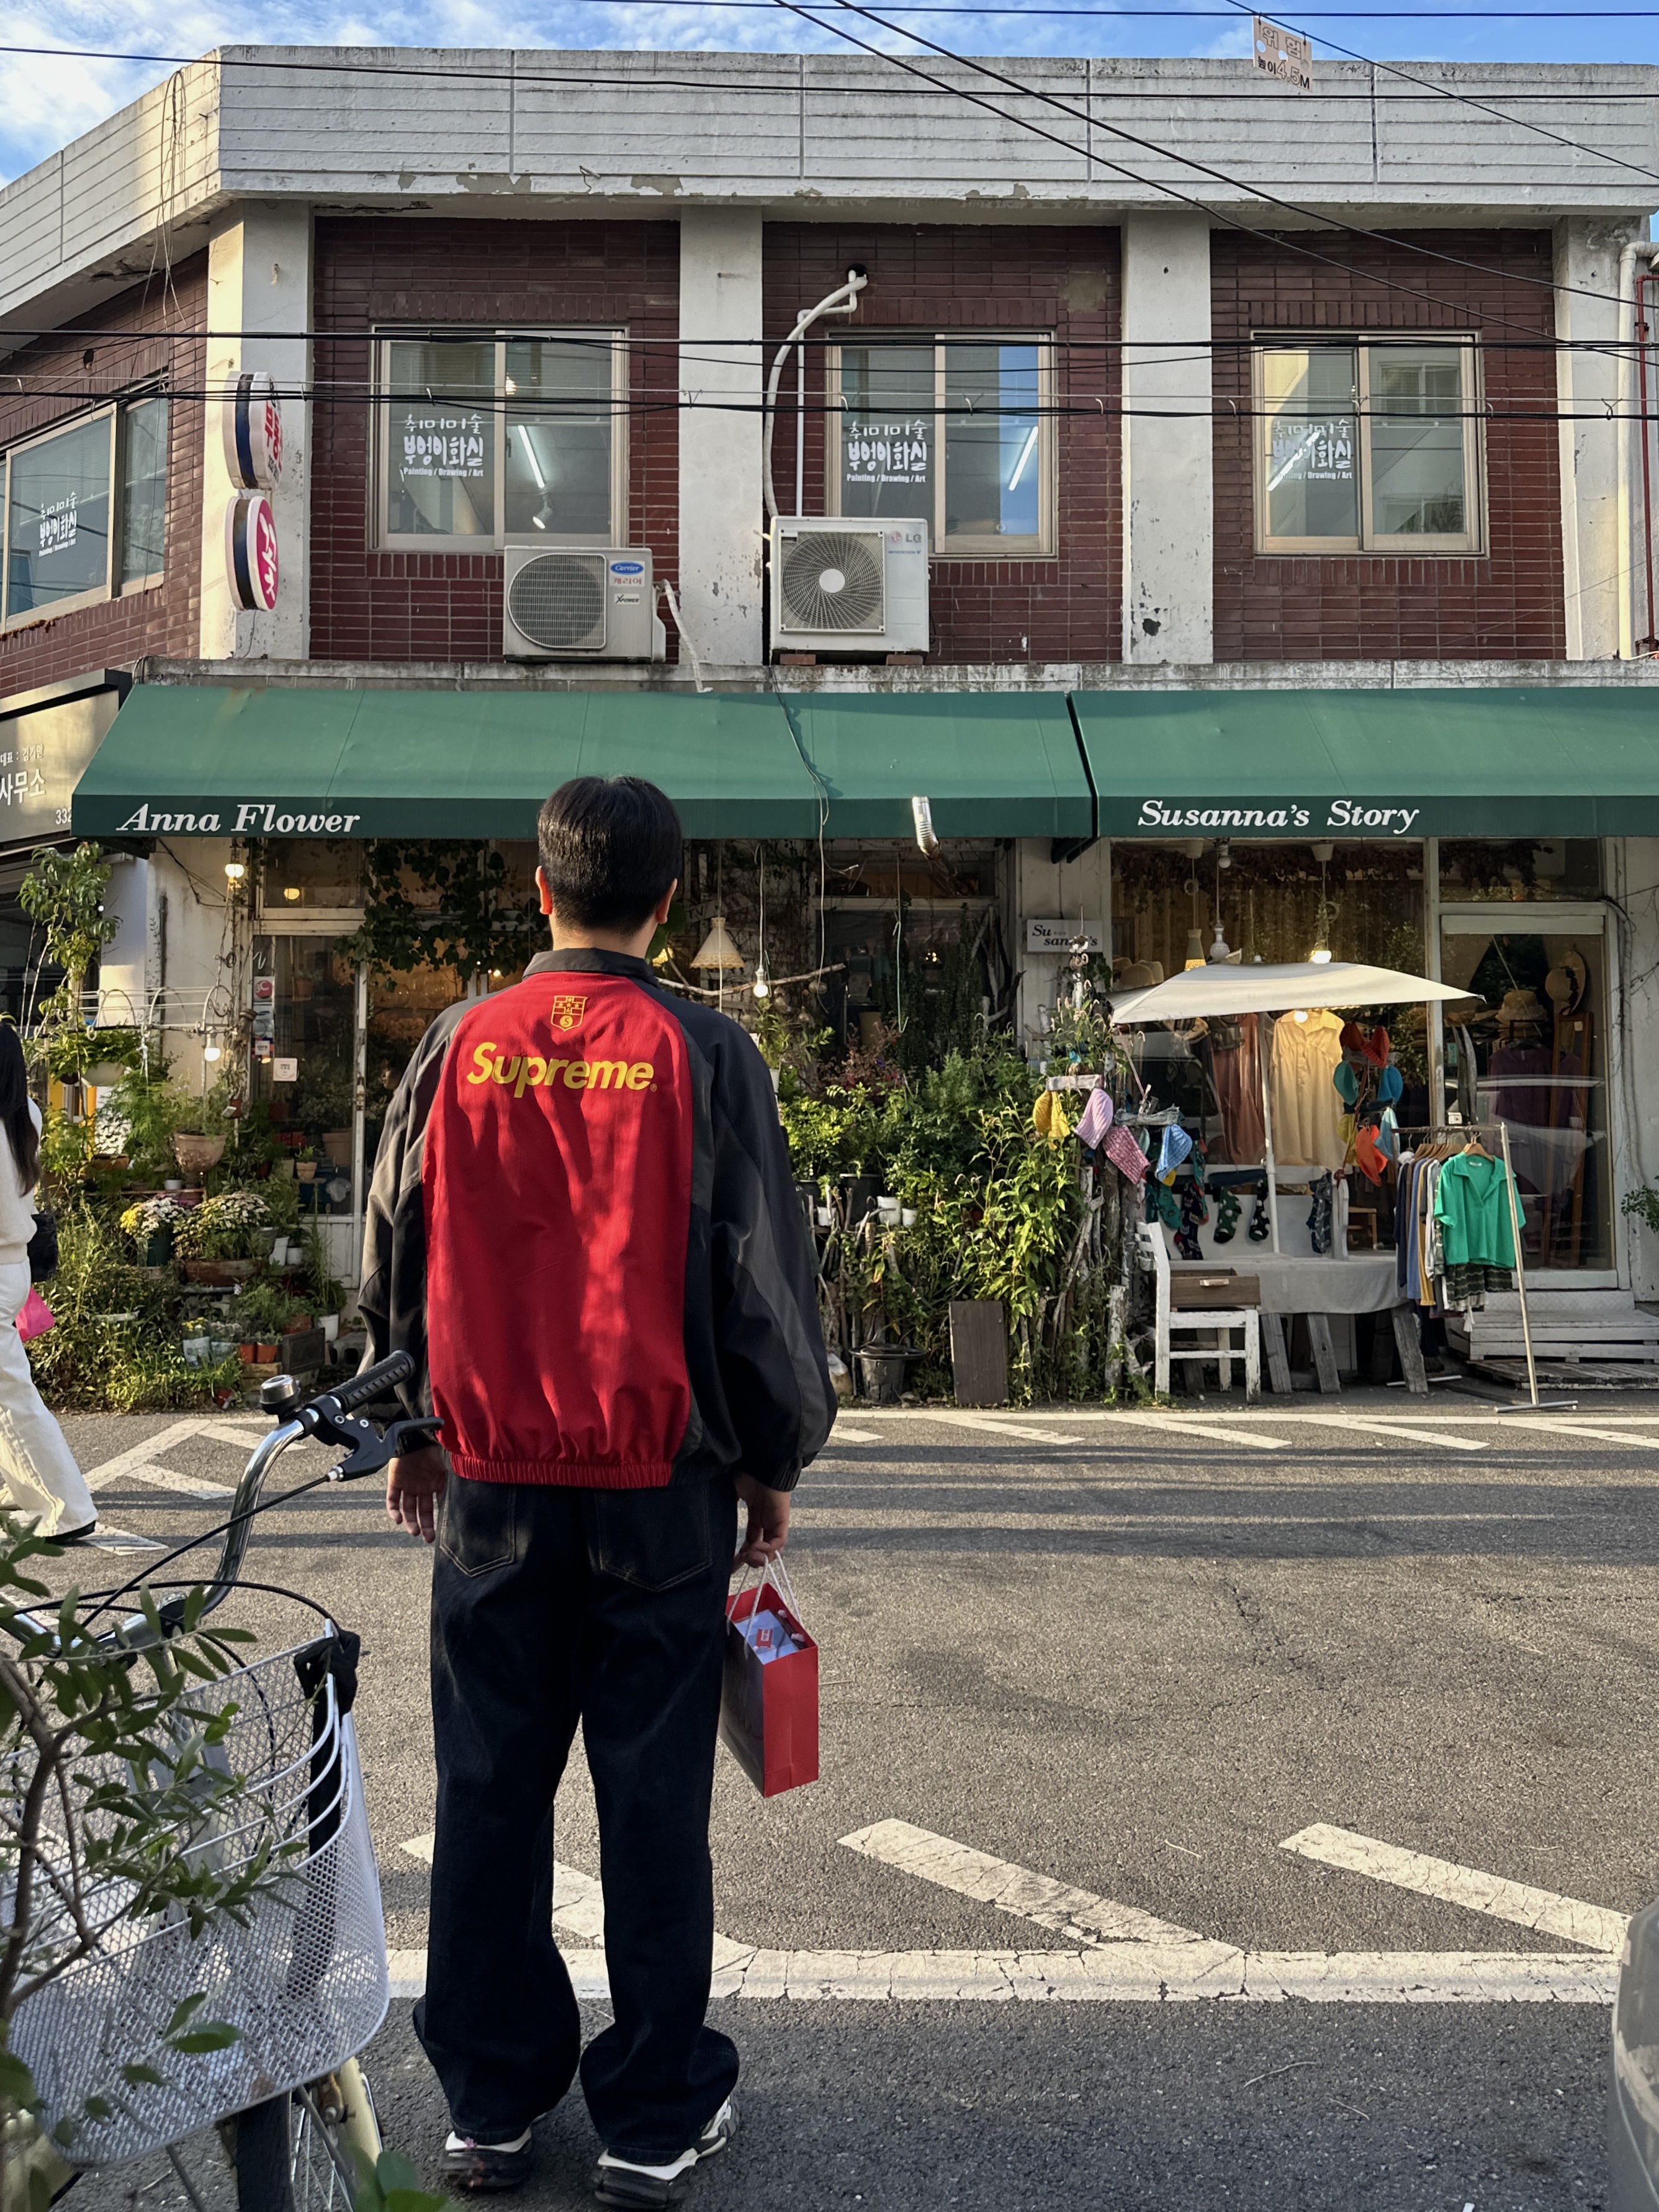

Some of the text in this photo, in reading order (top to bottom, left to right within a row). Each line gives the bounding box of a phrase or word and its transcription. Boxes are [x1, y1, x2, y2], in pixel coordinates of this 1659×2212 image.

[405, 413, 483, 434] 취미미술
[848, 419, 927, 440] 취미미술
[404, 435, 483, 467] 부엉이화실
[848, 441, 927, 472] 부엉이화실
[404, 467, 433, 476] Painting
[438, 468, 466, 477] Drawing
[473, 469, 483, 477] Art
[847, 474, 875, 482] Painting
[881, 474, 909, 483] Drawing
[1307, 472, 1336, 480] Drawing
[906, 534, 922, 543] LG
[116, 803, 361, 833] Anna Flower
[1138, 800, 1420, 835] Susanna's Story
[1032, 924, 1052, 937] Su
[467, 1041, 654, 1098] Supreme
